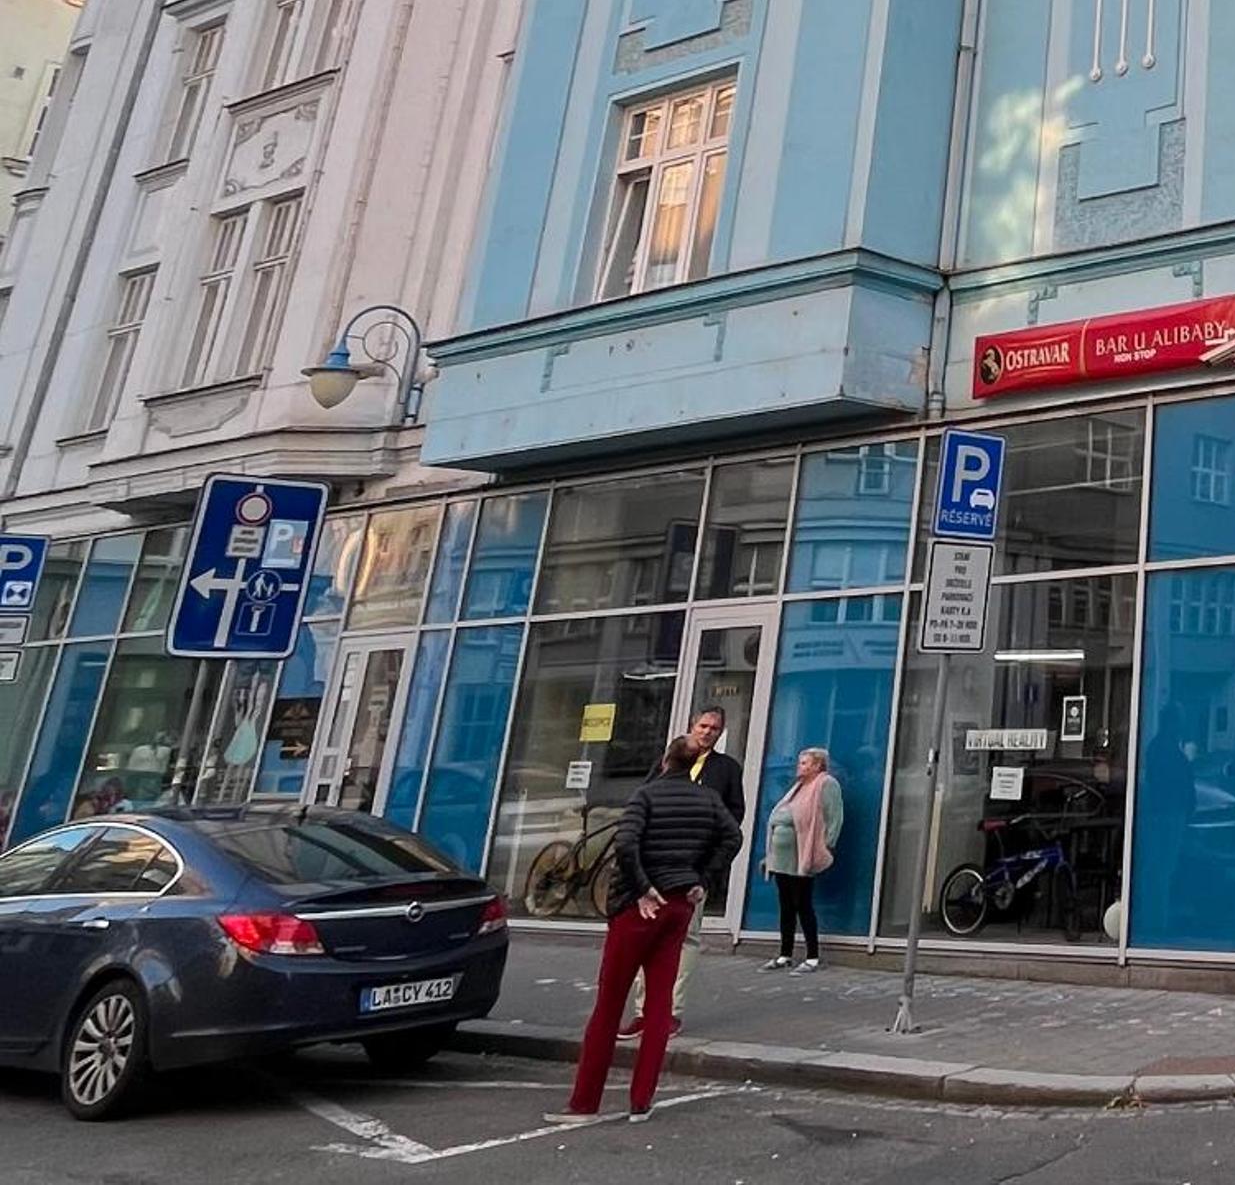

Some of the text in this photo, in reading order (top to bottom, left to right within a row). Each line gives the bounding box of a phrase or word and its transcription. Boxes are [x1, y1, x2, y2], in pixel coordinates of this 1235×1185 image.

[1096, 319, 1226, 356] BAR U ALIBABY
[1006, 342, 1070, 371] OSTRAVAR
[1114, 348, 1157, 363] NON STOP
[951, 444, 991, 503] P
[269, 523, 295, 552] P
[372, 980, 452, 1007] LA CY 412
